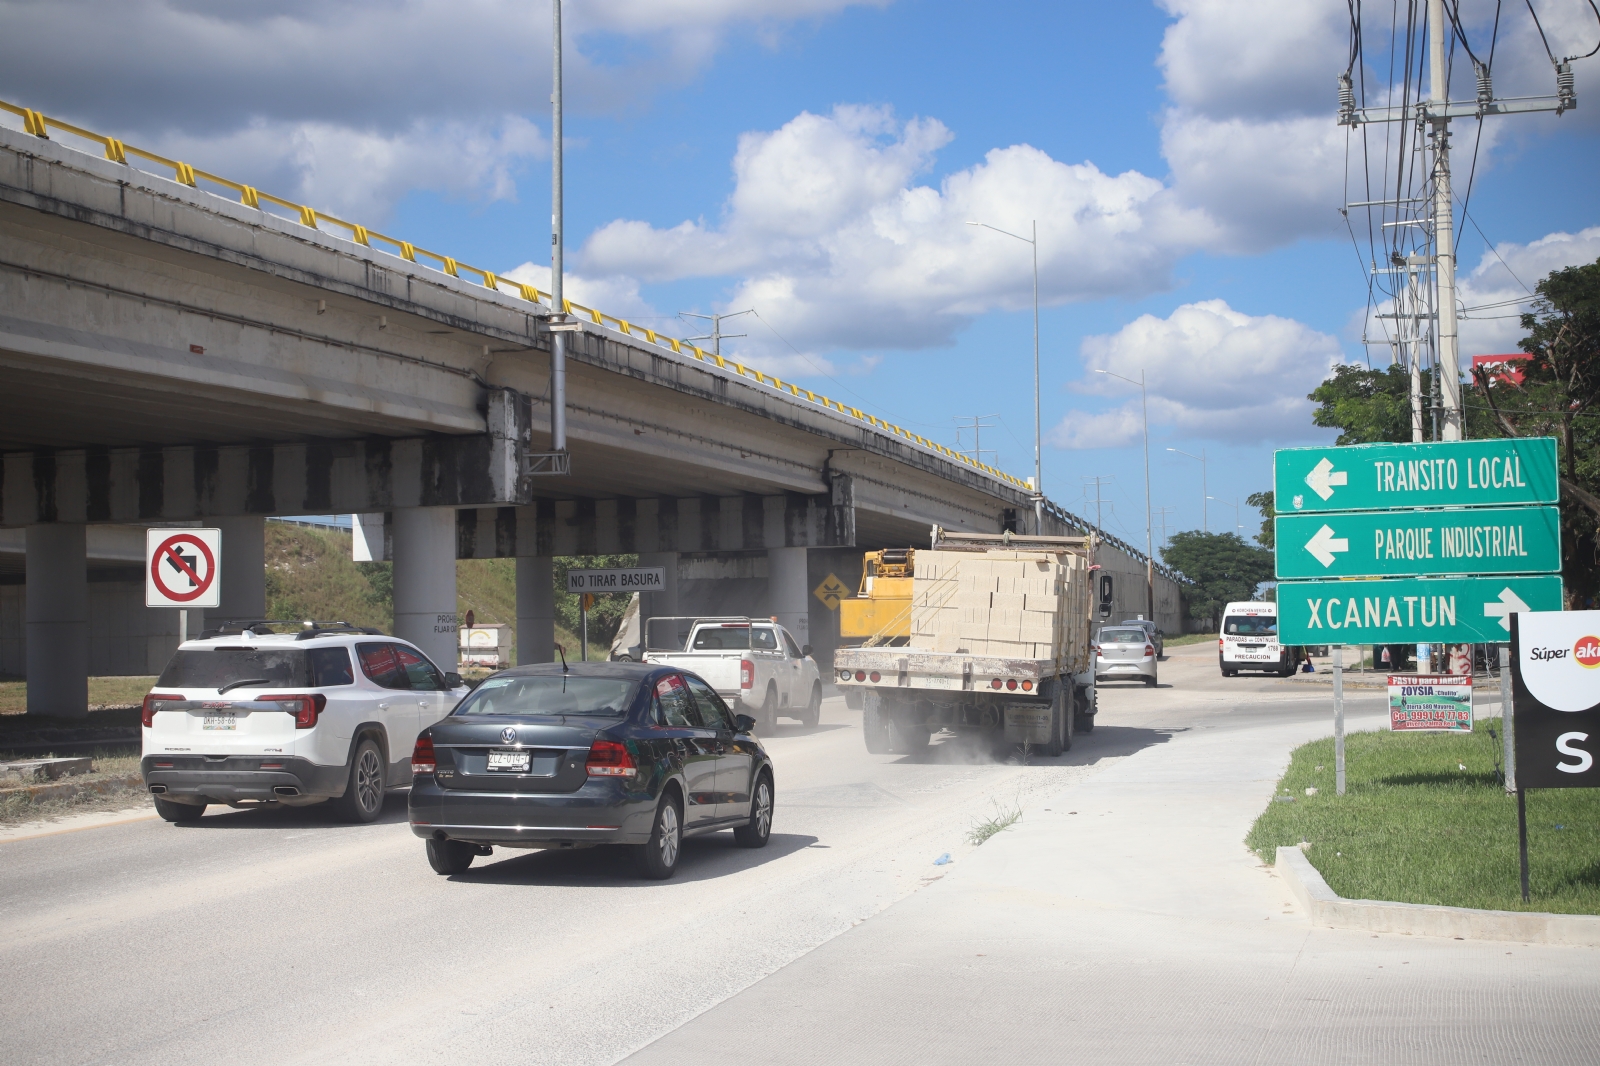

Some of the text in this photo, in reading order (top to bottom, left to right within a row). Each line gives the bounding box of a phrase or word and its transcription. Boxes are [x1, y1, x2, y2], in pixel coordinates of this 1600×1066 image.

[1374, 456, 1526, 492] TRANSITO LOCAL
[1375, 525, 1528, 560] PARQUE INDUSTRIAL
[571, 573, 661, 588] NO TIRAR BASURA
[1306, 595, 1456, 630] XCANATUN
[1530, 647, 1570, 662] Súper
[1392, 676, 1417, 685] PASTO
[1401, 686, 1434, 696] ZOYSIA
[1411, 711, 1433, 720] 9991
[1434, 711, 1445, 720] 44
[1447, 711, 1456, 720] 77
[1457, 711, 1469, 721] 83
[1555, 731, 1593, 774] S
